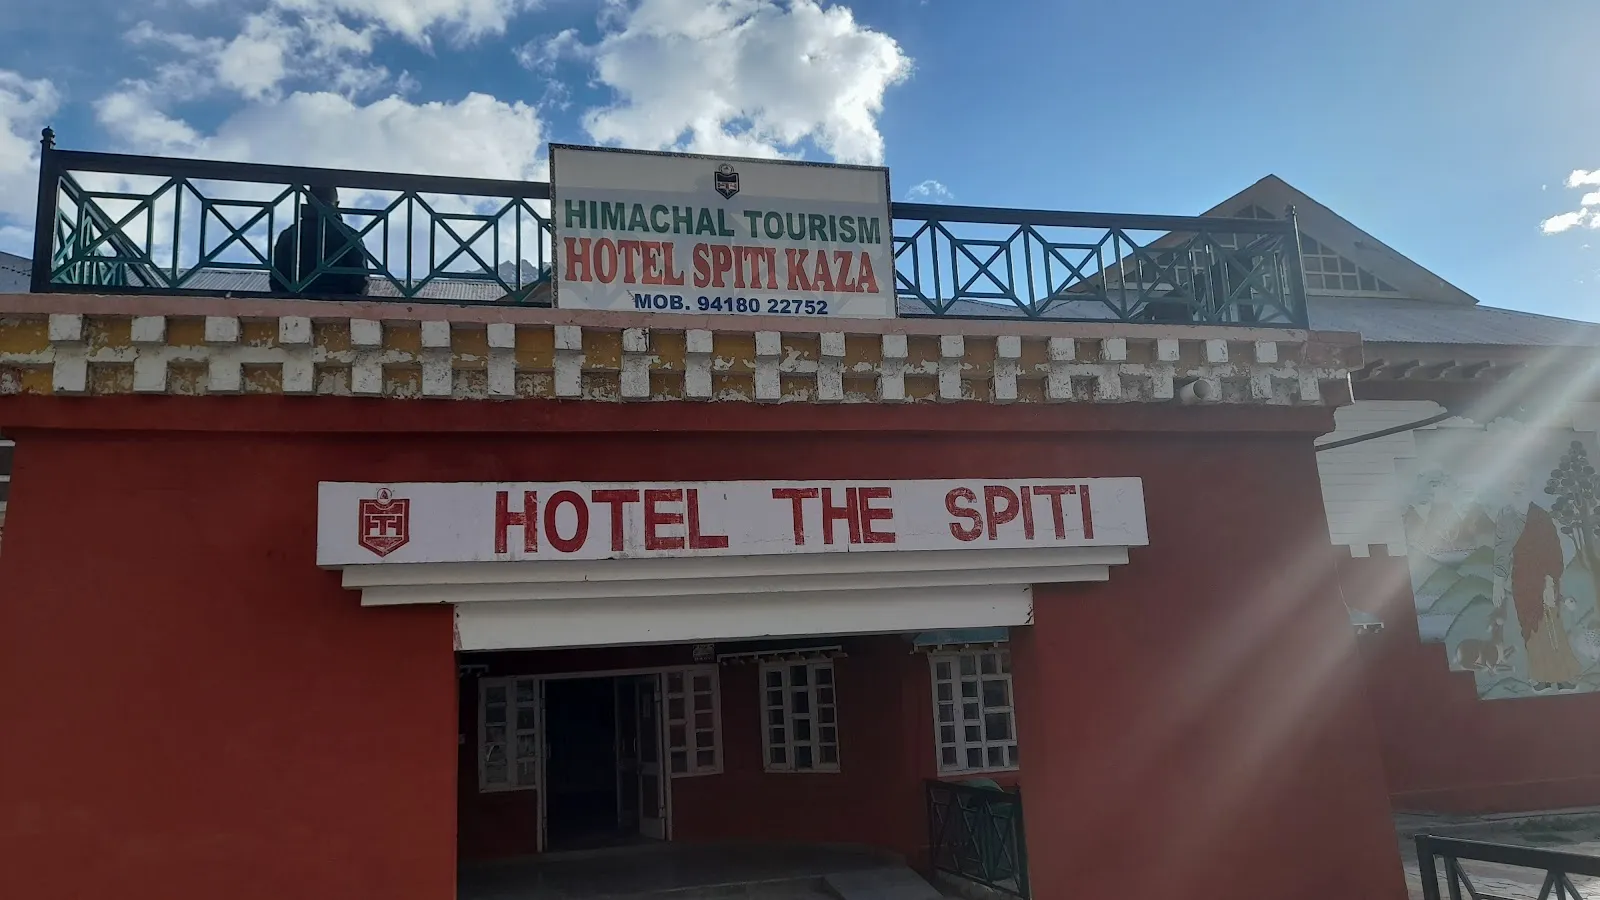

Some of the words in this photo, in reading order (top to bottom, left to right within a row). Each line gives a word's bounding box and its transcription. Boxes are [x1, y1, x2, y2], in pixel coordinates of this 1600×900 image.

[564, 199, 735, 237] HIMACHAL
[744, 210, 881, 244] TOURISM
[563, 237, 685, 286] HOTEL
[692, 242, 779, 290] SPITI
[785, 247, 880, 293] KAZA
[634, 293, 691, 311] MOB.
[697, 295, 761, 314] 94180
[767, 298, 829, 315] 22752
[494, 488, 729, 553] HOTEL
[771, 486, 896, 546] THE
[944, 484, 1095, 542] SPITI
